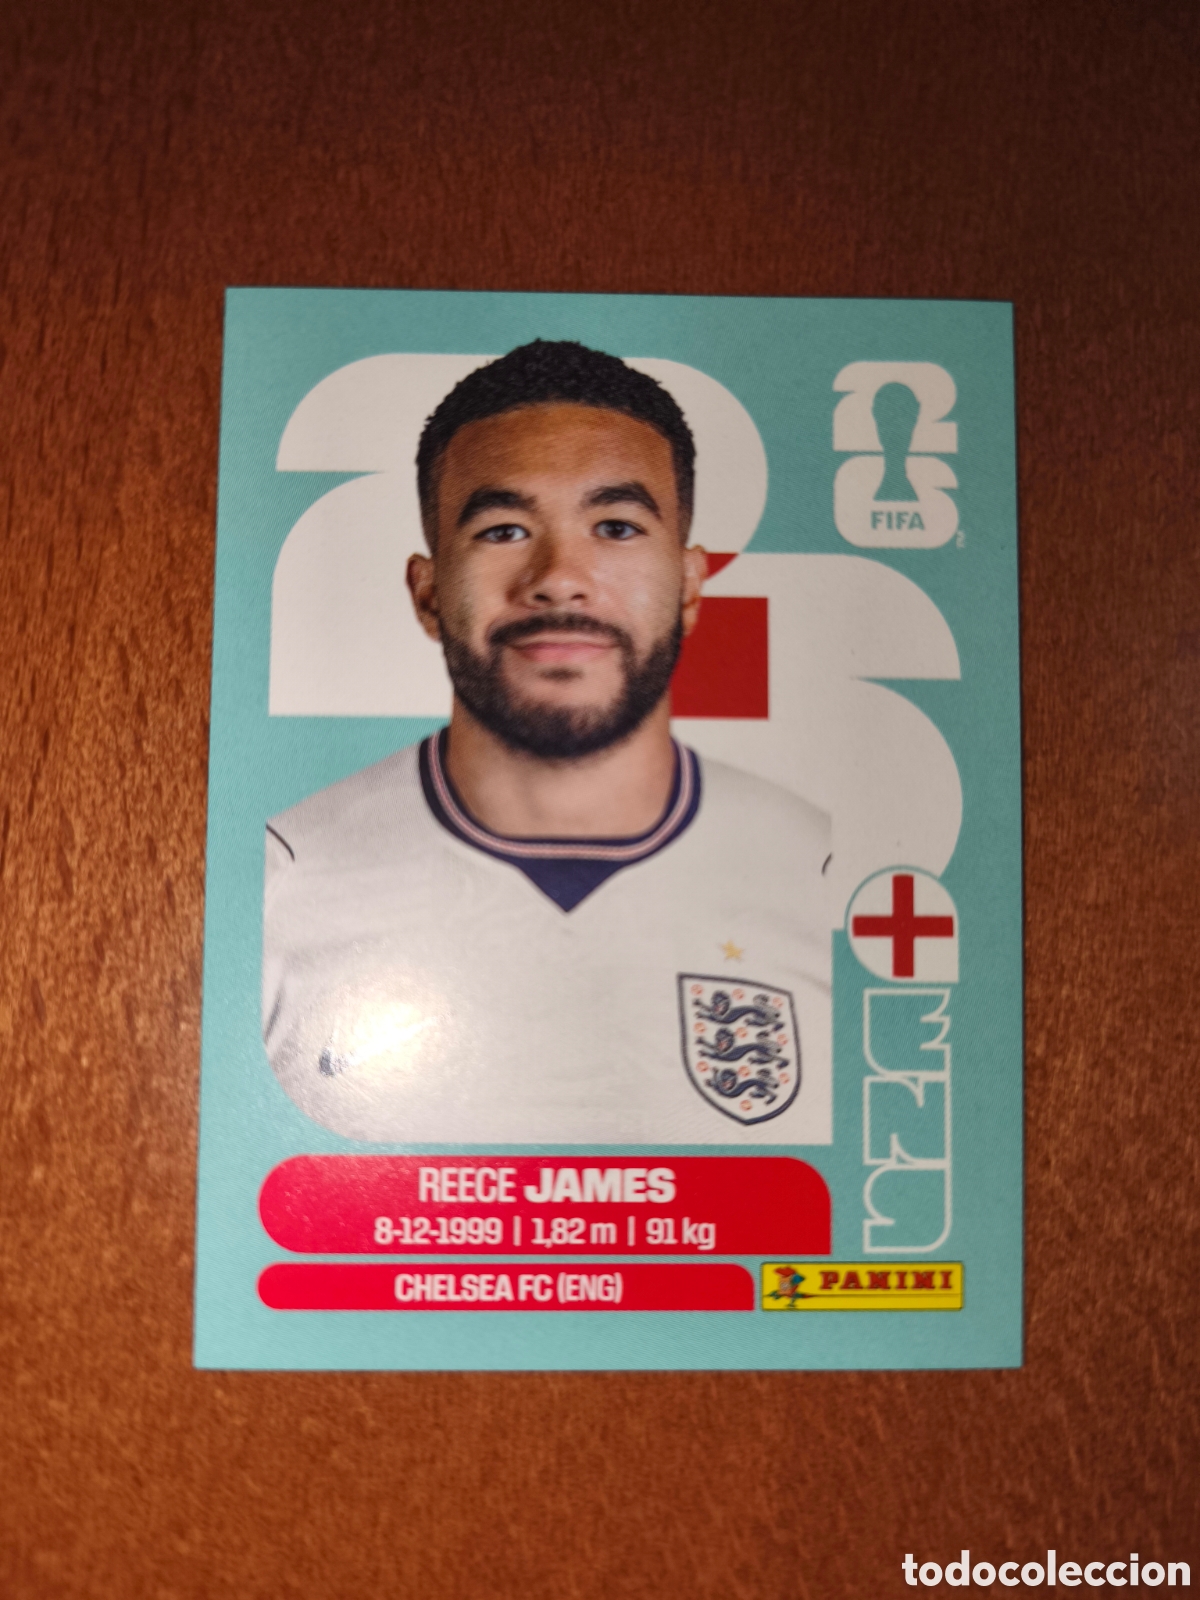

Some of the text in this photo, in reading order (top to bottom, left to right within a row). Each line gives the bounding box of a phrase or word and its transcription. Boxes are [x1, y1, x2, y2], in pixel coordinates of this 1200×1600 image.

[871, 510, 926, 531] FIFA
[418, 1166, 676, 1203] REECE JAMES
[373, 1215, 503, 1246] 8-12-1999
[531, 1217, 586, 1249] 1,82
[590, 1221, 617, 1245] m
[645, 1217, 678, 1245] 91
[681, 1216, 716, 1250] kg
[394, 1271, 623, 1304] CHELSEA FC (ENG)
[818, 1269, 954, 1291] PANINI
